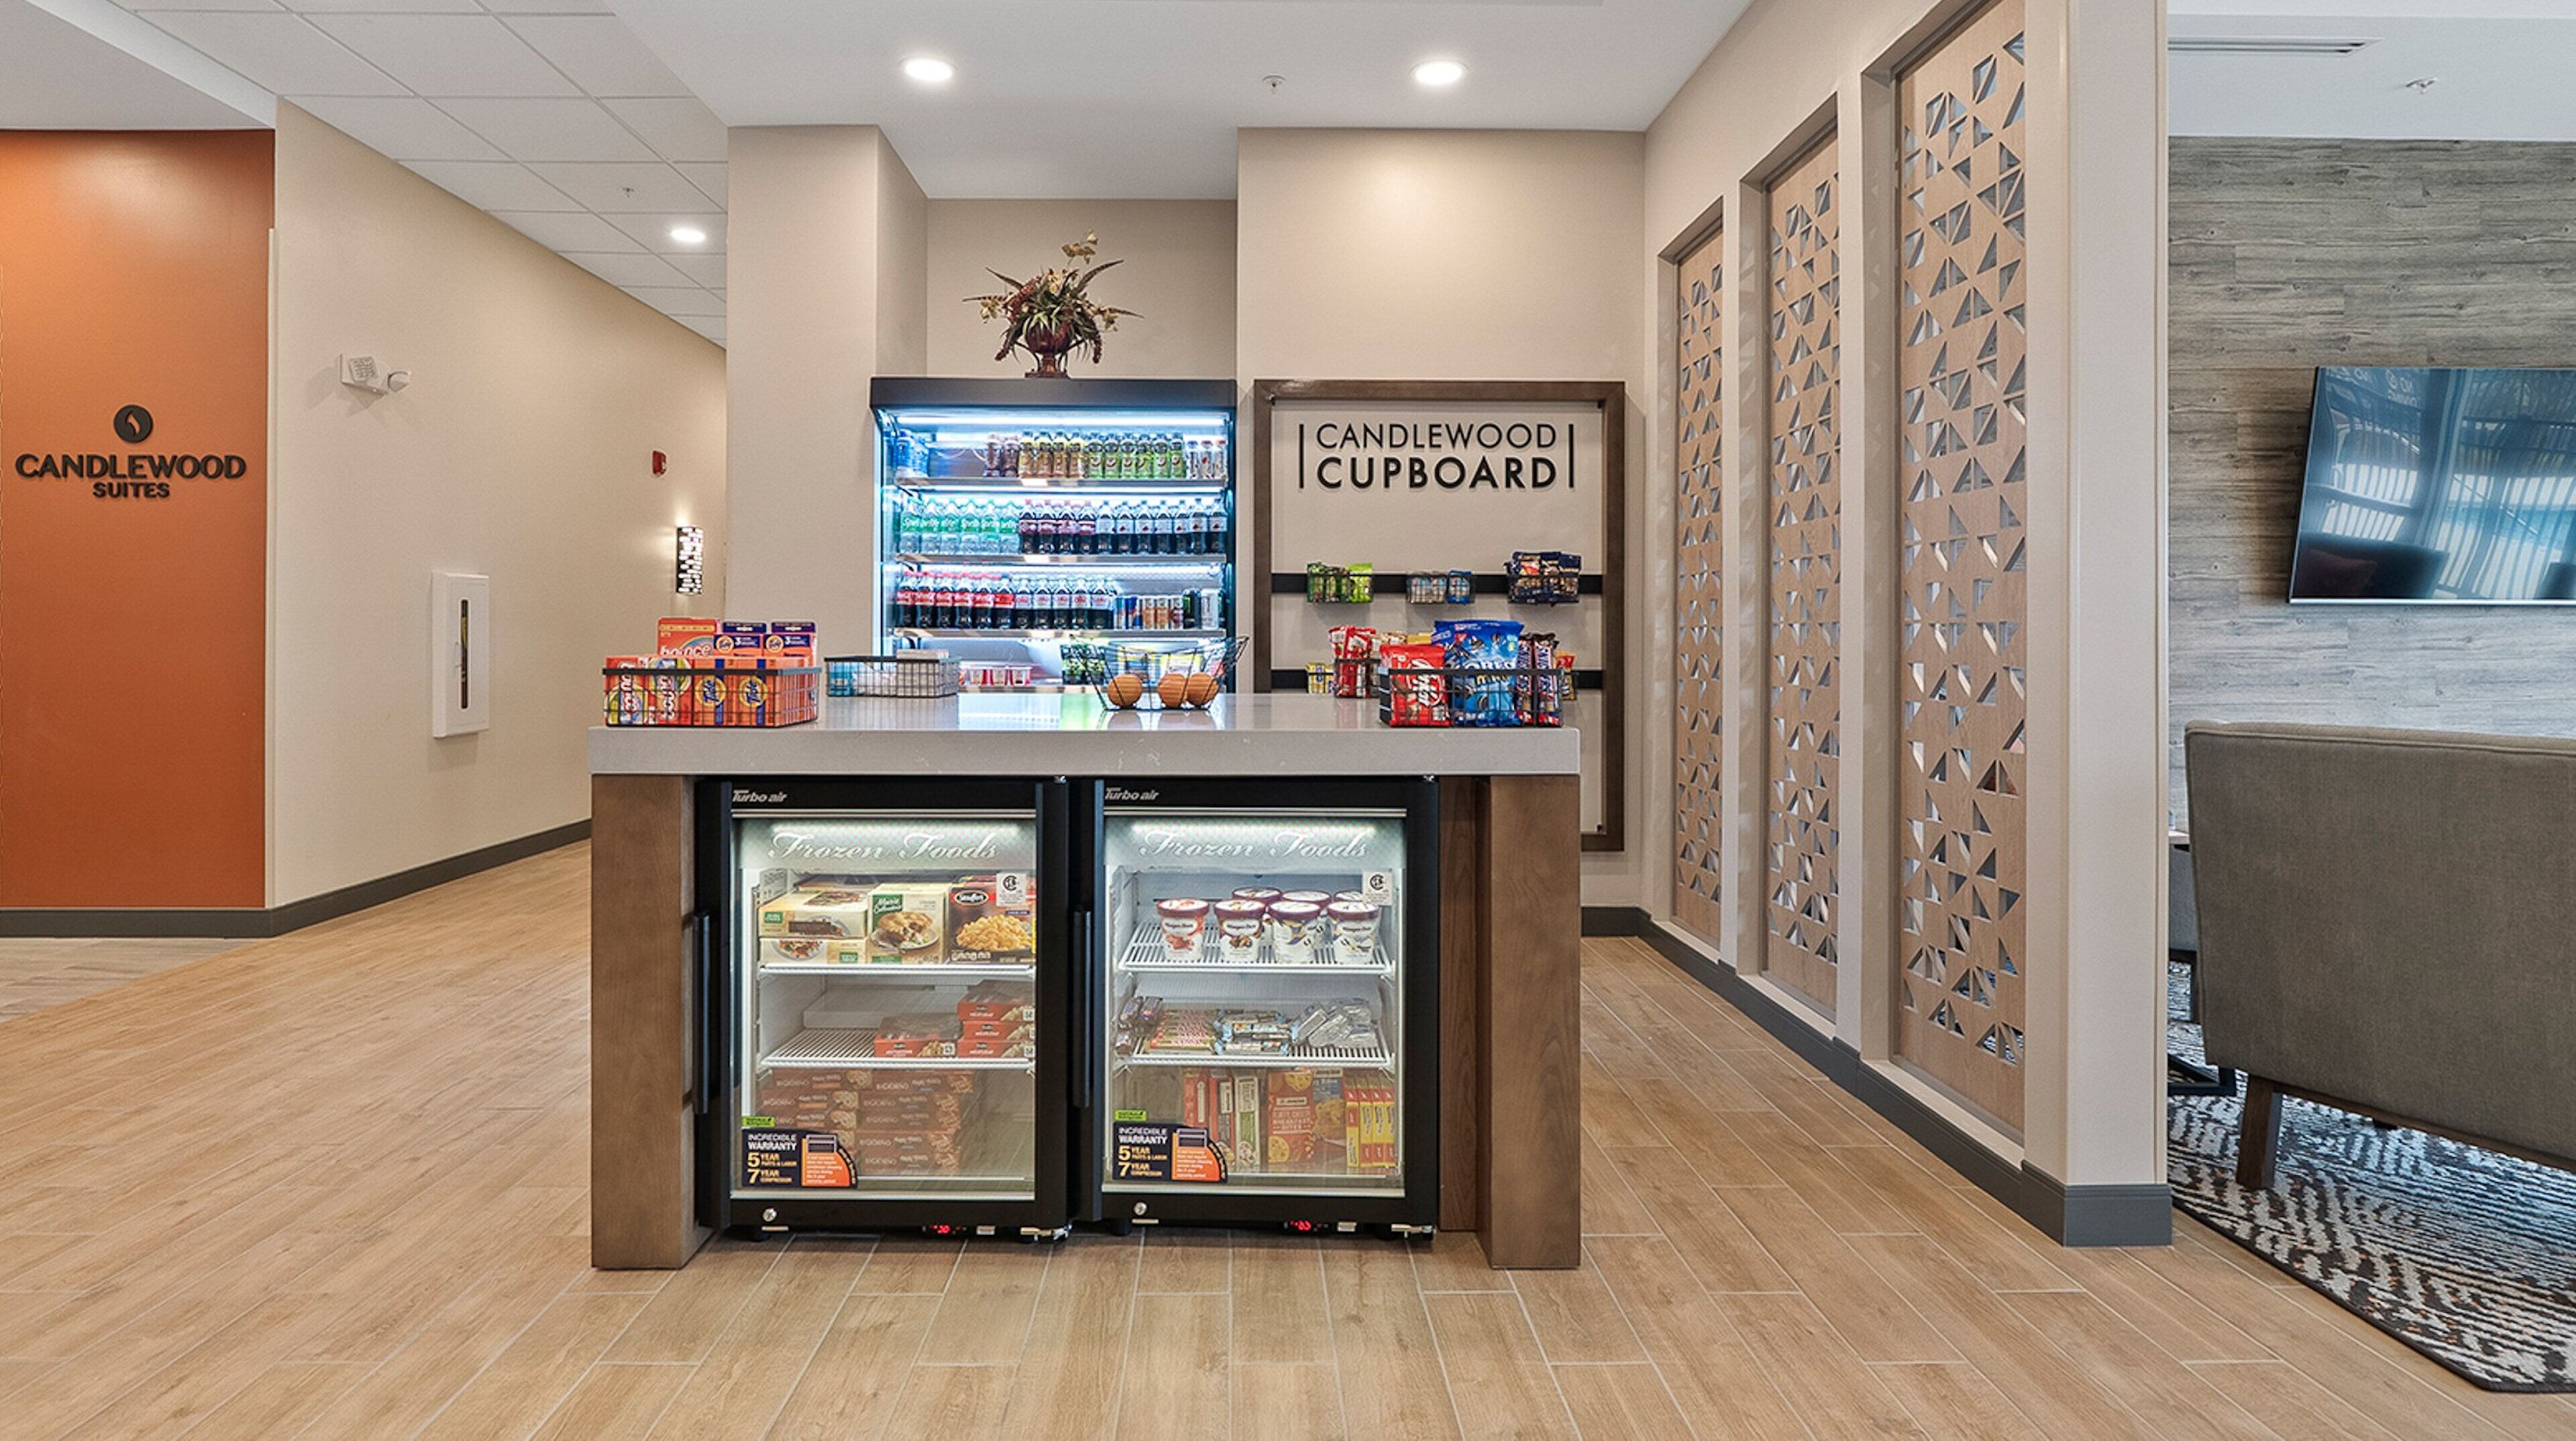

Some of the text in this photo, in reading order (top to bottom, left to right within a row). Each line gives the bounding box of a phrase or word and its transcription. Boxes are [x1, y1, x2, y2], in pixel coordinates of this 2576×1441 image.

[1316, 423, 1556, 449] CANDLEWOOD
[15, 453, 246, 479] CANDLEWOOD
[1317, 456, 1557, 489] CUPBOARD
[93, 482, 170, 498] SUITES
[732, 789, 788, 802] Turbo air
[1105, 787, 1160, 800] Turbo air
[768, 832, 998, 859] Frozen Foods
[1140, 830, 1373, 857] Frozen Foods
[747, 1142, 797, 1151] WARRANTY
[1118, 1136, 1168, 1144] WARRANTY
[747, 1152, 780, 1168] 5 YEAR
[1118, 1145, 1150, 1161] 5 YEAR
[747, 1169, 780, 1185] 7 YEAR
[1118, 1162, 1150, 1177] 7 YEAR
